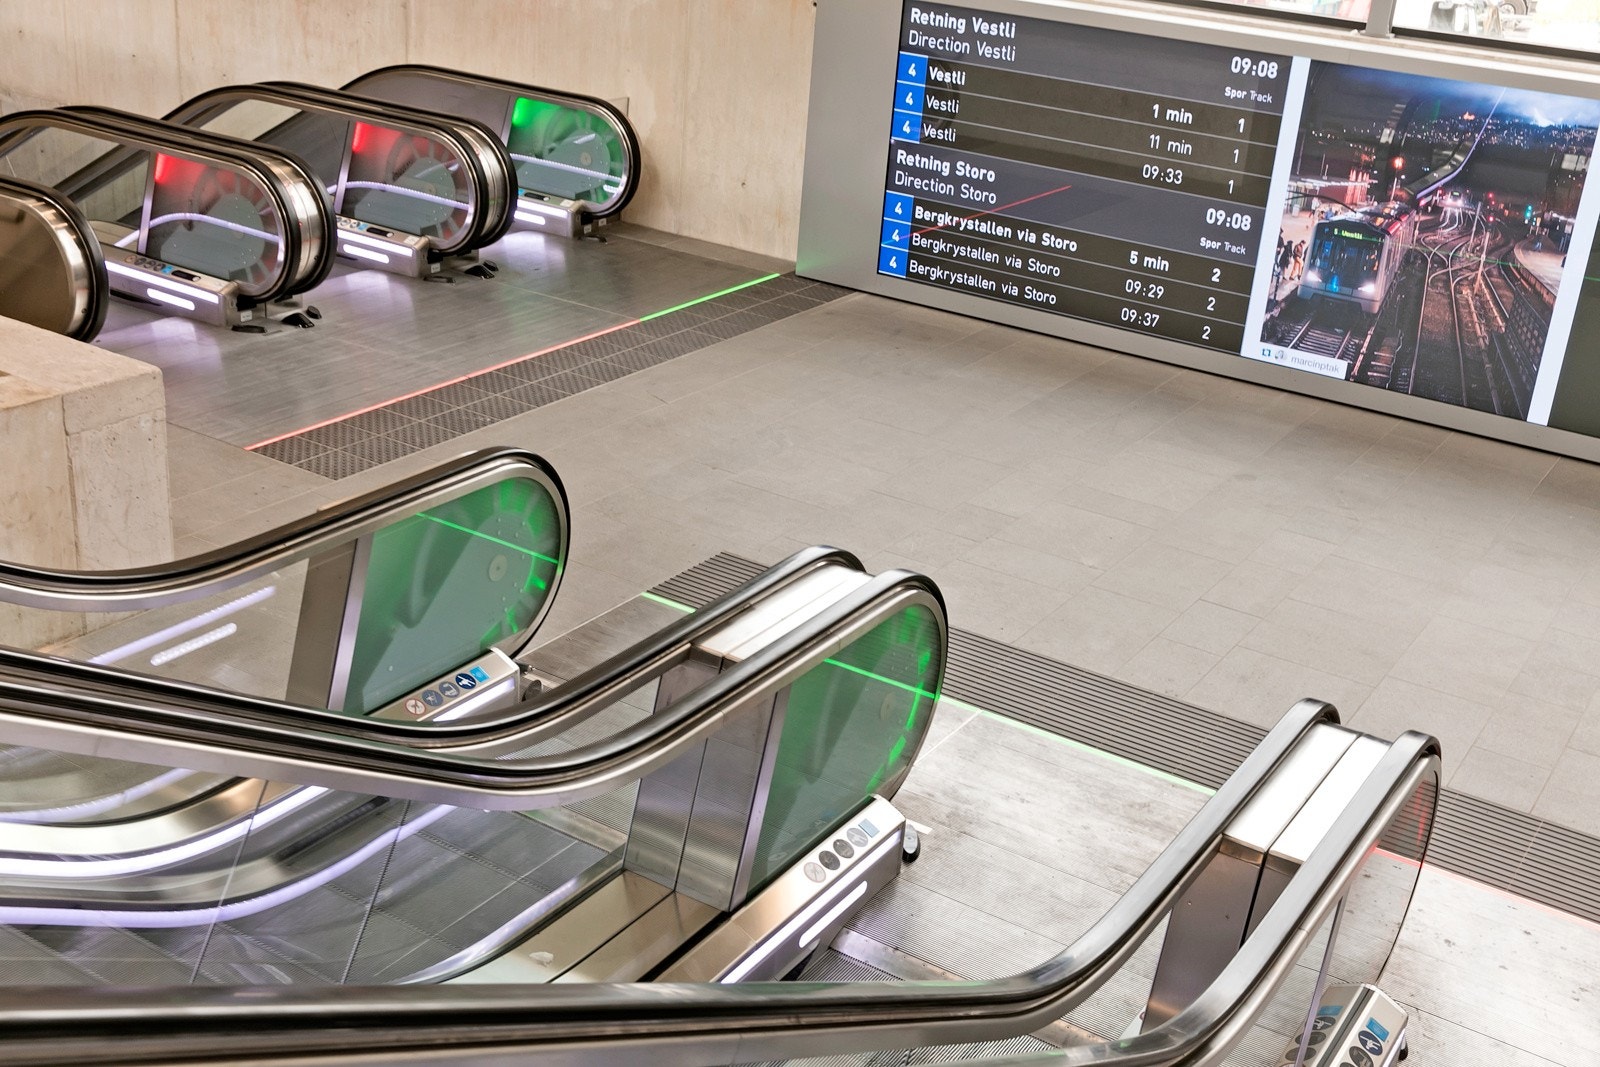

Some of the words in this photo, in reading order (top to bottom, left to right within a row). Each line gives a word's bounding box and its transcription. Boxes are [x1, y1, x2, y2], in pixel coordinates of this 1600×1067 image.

[910, 7, 966, 33] Retning
[972, 17, 1016, 39] Vestli
[908, 30, 971, 55] Direction
[976, 40, 1016, 62] Vestli
[1230, 56, 1278, 79] 09:08
[908, 64, 916, 77] 4
[929, 66, 966, 85] Vestli
[1152, 103, 1160, 119] 1
[1166, 107, 1193, 125] min
[1238, 118, 1245, 133] 1
[1224, 86, 1247, 101] Spor
[1250, 90, 1272, 103] Track
[905, 92, 914, 105] 4
[926, 95, 960, 114] Vestli
[1149, 134, 1161, 150] 11
[1168, 138, 1192, 156] min
[1233, 148, 1239, 164] 1
[896, 149, 952, 177] Retning
[956, 161, 996, 182] Storo
[903, 120, 911, 134] 4
[923, 124, 956, 142] Vestli
[1142, 164, 1183, 185] 09:33
[1228, 179, 1234, 194] 1
[895, 170, 955, 196] Direction
[960, 184, 997, 204] Storo
[1206, 208, 1252, 231] 09:08
[895, 201, 903, 215] 4
[914, 205, 1012, 238] Bergkrystallen
[1017, 227, 1037, 243] via
[1041, 231, 1078, 252] Storo
[1130, 251, 1138, 265] 5
[1143, 253, 1169, 271] min
[1211, 268, 1221, 282] 2
[1200, 236, 1222, 252] Spor
[1224, 241, 1246, 255] Track
[891, 229, 900, 242] 4
[912, 233, 1000, 265] Bergkrystallen
[1005, 254, 1023, 269] via
[1027, 258, 1061, 277] Storo
[1125, 279, 1164, 299] 09:29
[1207, 297, 1215, 311] 2
[889, 256, 898, 269] 4
[909, 259, 996, 291] Bergkrystallen
[1001, 281, 1018, 296] via
[1024, 285, 1057, 305] Storo
[1121, 307, 1160, 328] 09:37
[1202, 325, 1211, 340] 2
